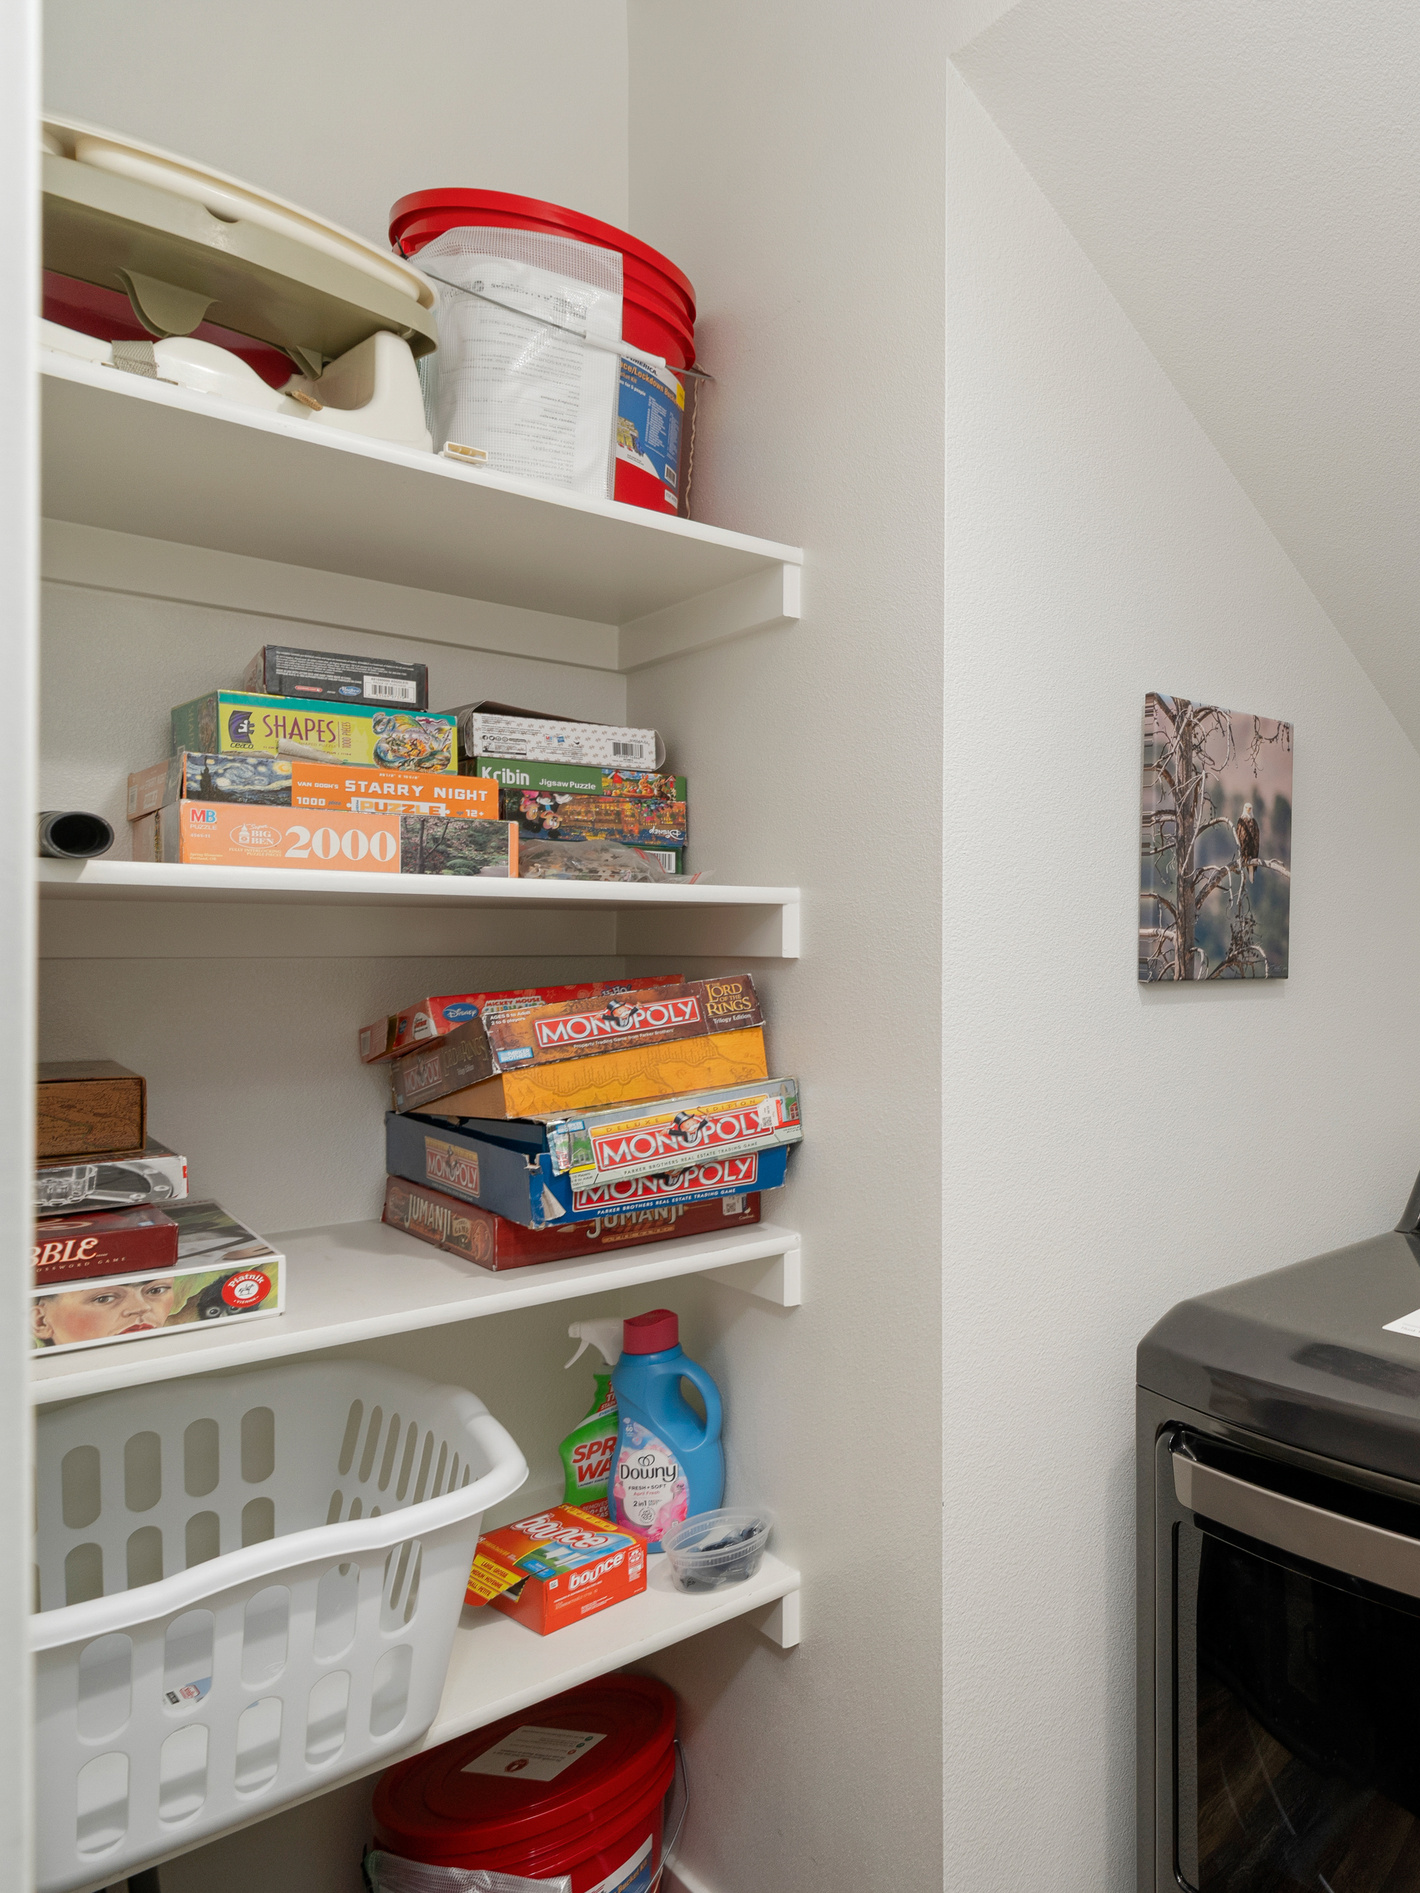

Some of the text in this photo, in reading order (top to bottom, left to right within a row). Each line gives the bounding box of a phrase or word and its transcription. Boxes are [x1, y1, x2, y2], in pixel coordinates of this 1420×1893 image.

[262, 714, 337, 743] SHAPES
[481, 766, 597, 791] Kribin Jigsaw Puzzle
[345, 779, 424, 797] STARRY
[433, 786, 488, 802] NIGHT
[190, 809, 217, 823] MB
[296, 796, 485, 817] 1000 PUZZLE 12+
[250, 830, 272, 838] BIG
[250, 836, 275, 846] BEN
[284, 824, 398, 863] 2000
[649, 826, 685, 841] Disney
[706, 983, 744, 1002] LORD
[728, 993, 742, 1001] THE
[447, 1006, 478, 1019] Disney
[706, 997, 752, 1017] RINGS
[541, 1001, 694, 1043] MONOPOLY
[713, 1013, 752, 1025] Trilogy Edition
[573, 1040, 595, 1049] Property
[595, 1037, 612, 1046] Trading
[613, 1035, 627, 1043] Game
[606, 1098, 757, 1133] DELUXE EDITION
[603, 1111, 766, 1166] MONOPOLY
[624, 1141, 758, 1175] PARKER BROTHERS REAL ESTATE TRADING GAME
[426, 1154, 479, 1189] MONOPOLY
[581, 1158, 752, 1204] MONOPOLY
[597, 1206, 620, 1215] PARKER
[622, 1200, 654, 1211] BROTHERS
[655, 1198, 671, 1206] REAL
[671, 1195, 692, 1204] ESTATE
[694, 1191, 719, 1200] TRADING
[404, 1193, 452, 1243] JUMANJI
[586, 1203, 685, 1239] JUMANJI
[97, 1256, 127, 1265] GAME
[227, 1273, 265, 1288] Piatnik
[620, 1463, 677, 1483] Downy
[513, 1513, 608, 1549] bounce
[481, 1561, 494, 1570] LARGE
[570, 1552, 624, 1590] bounce
